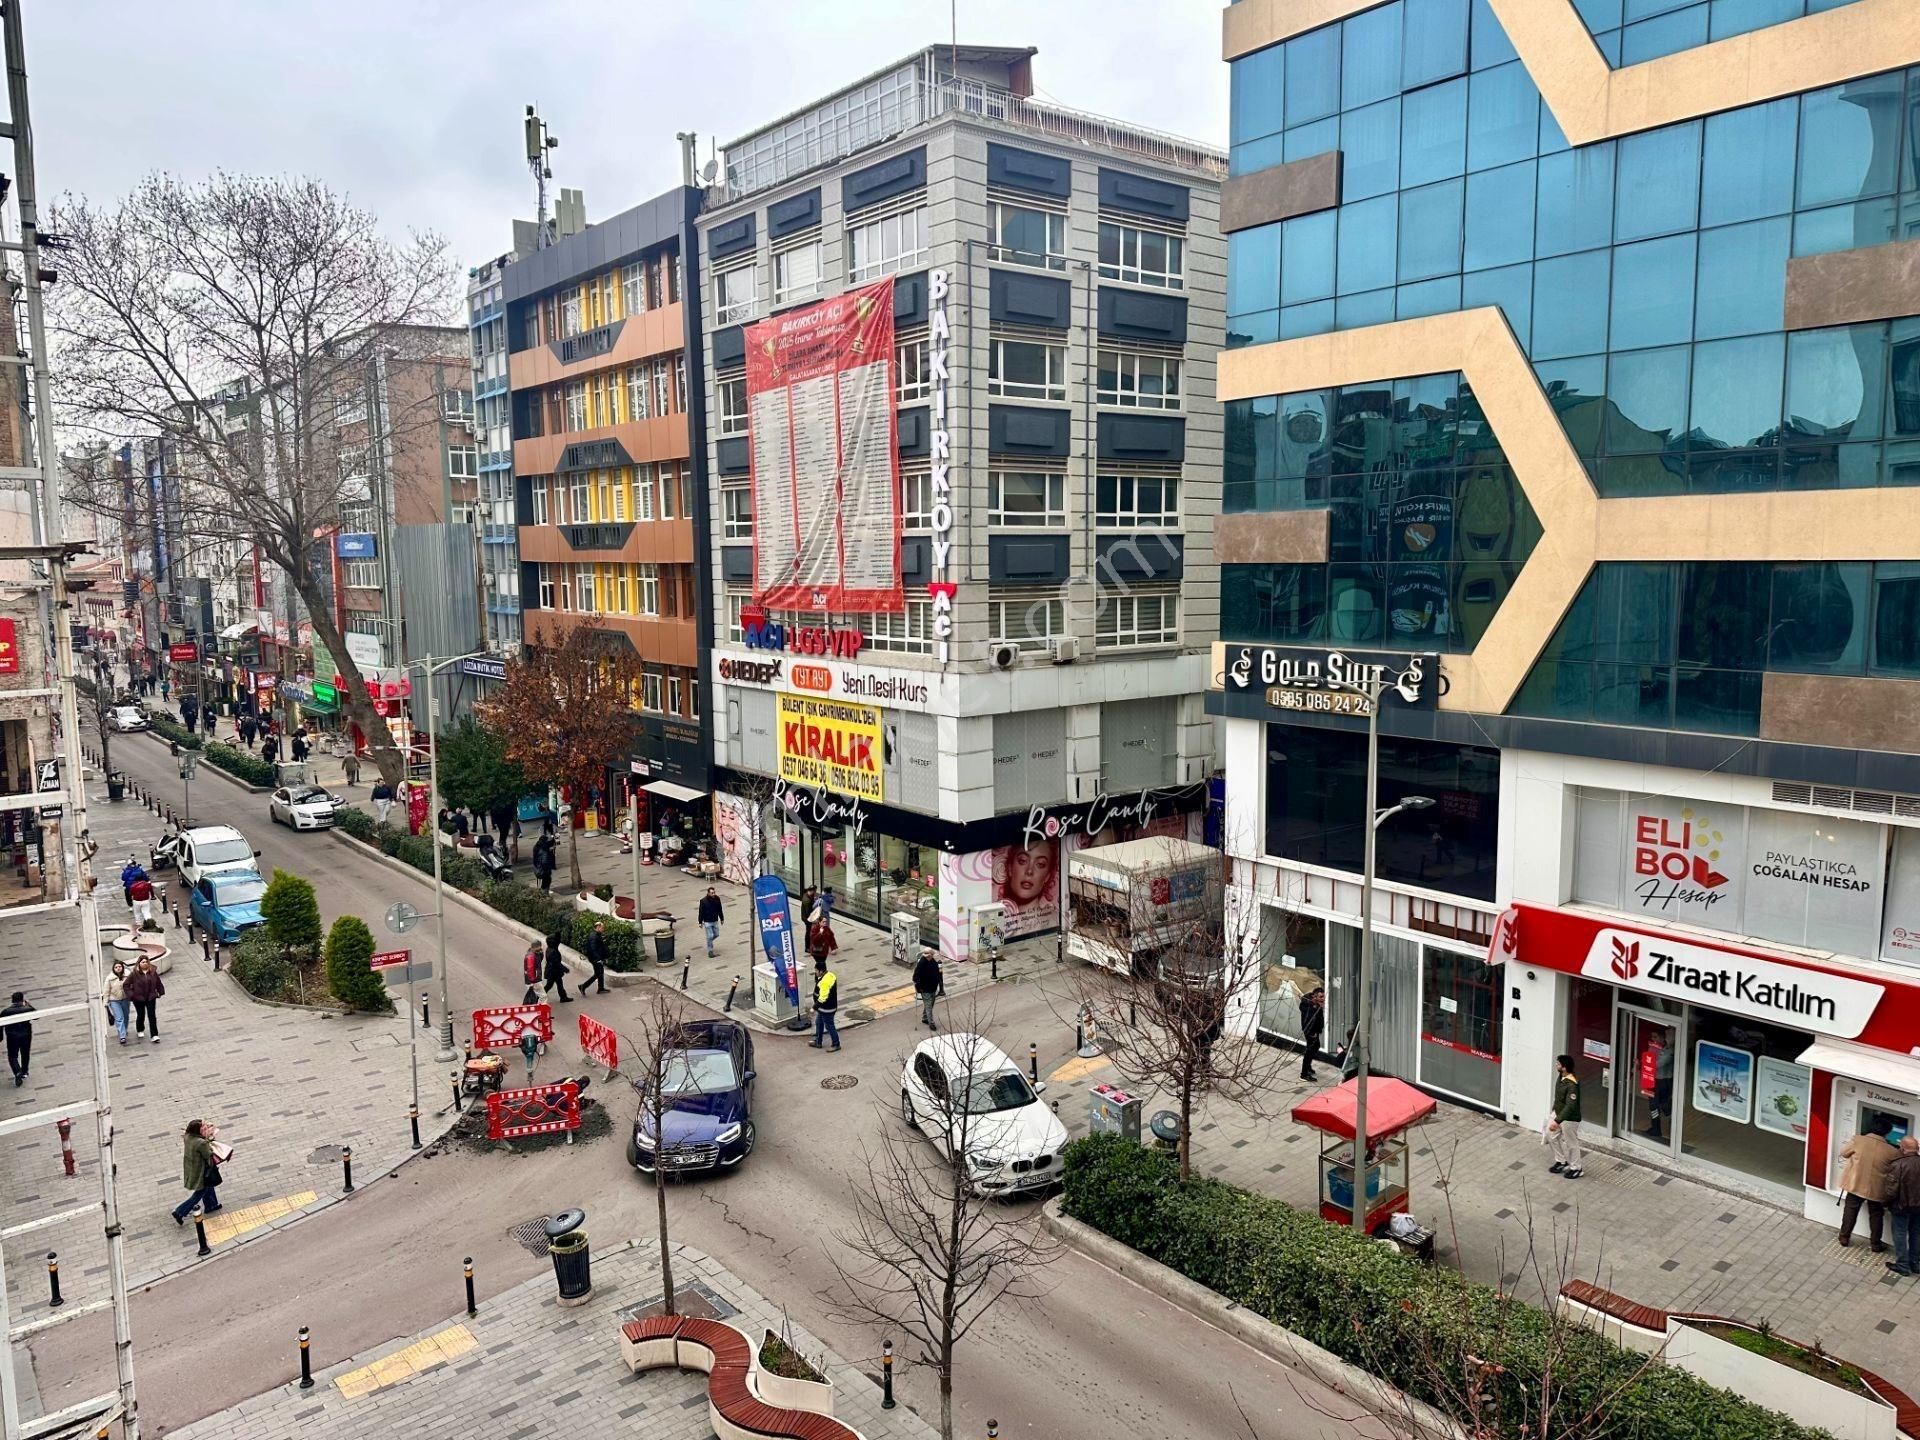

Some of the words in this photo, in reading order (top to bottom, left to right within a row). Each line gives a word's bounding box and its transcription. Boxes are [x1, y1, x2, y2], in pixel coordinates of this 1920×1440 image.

[781, 310, 824, 332] BAKIRKÖY
[929, 269, 952, 569] BAKIRKÖY
[790, 627, 826, 656] LGS
[829, 629, 863, 658] VIP
[795, 667, 810, 686] TYT
[842, 671, 866, 696] Yeni
[899, 677, 928, 704] Kurs
[1306, 693, 1331, 711] 085
[1335, 696, 1350, 712] 24
[1355, 697, 1371, 714] 24
[783, 697, 804, 713] BÜLENT
[784, 716, 875, 771] KİRALIK
[782, 756, 796, 776] 0537
[797, 760, 809, 779] 046
[810, 762, 818, 781] 64
[819, 763, 827, 784] 36
[847, 770, 860, 792] 832
[861, 774, 870, 794] 03
[870, 776, 879, 796] 95
[772, 775, 811, 814] Rose
[811, 783, 869, 836] Candy
[1023, 803, 1083, 852] Rose
[1086, 788, 1158, 836] Candy
[1635, 847, 1730, 889] BOL
[1752, 864, 1819, 884] ÇOĞALAN
[1823, 875, 1870, 892] HESAP
[1766, 851, 1857, 876] PAYLAŞTIKÇA
[1634, 878, 1727, 911] Hesap
[1647, 952, 1731, 996] Ziraat
[1735, 971, 1836, 1021] Katılım
